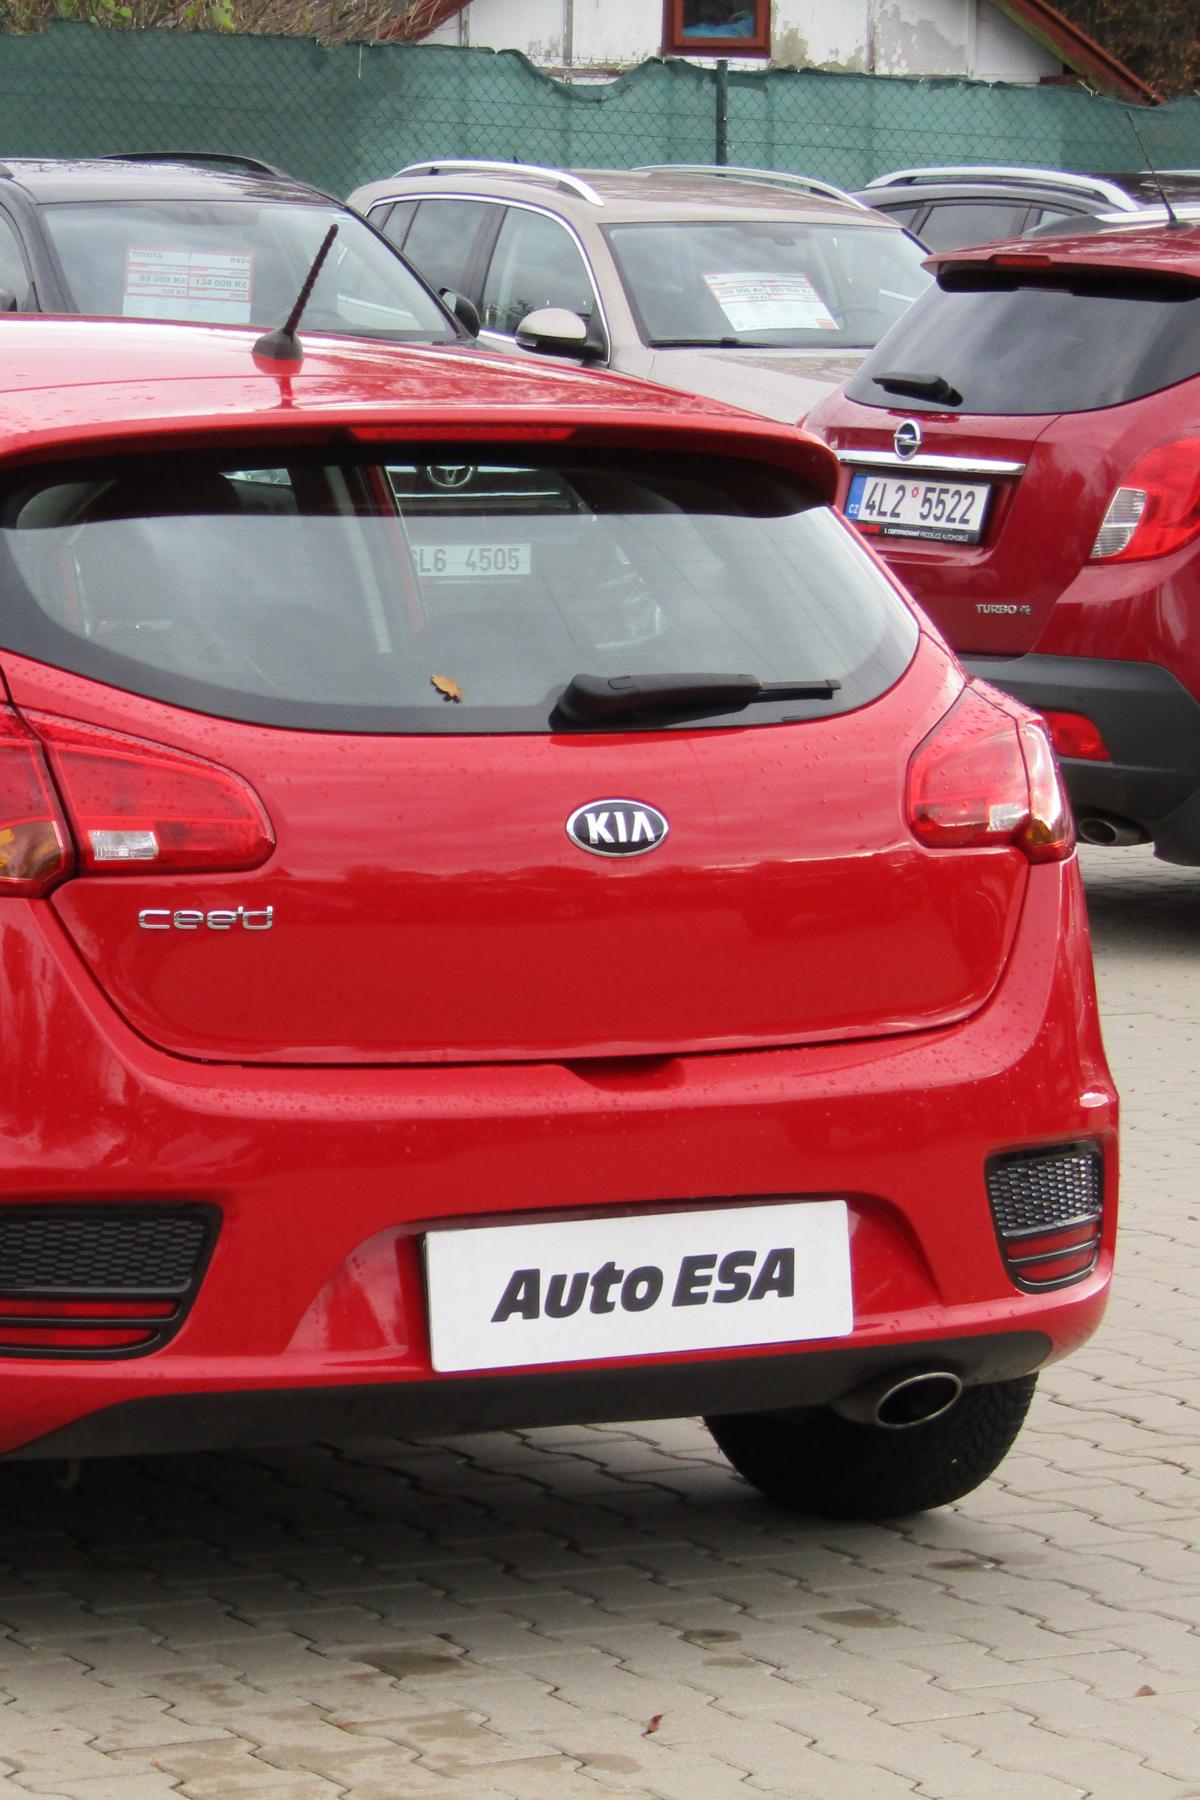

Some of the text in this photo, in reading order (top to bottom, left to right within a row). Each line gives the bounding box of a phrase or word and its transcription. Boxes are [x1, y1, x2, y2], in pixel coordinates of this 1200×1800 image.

[131, 250, 163, 259] TOYOTA
[174, 276, 187, 285] Kč
[195, 278, 248, 289] 134 000 Kč
[848, 504, 860, 514] CZ
[864, 482, 976, 525] 4L2 5522
[465, 547, 521, 572] 4505
[975, 604, 1018, 615] TURBO
[583, 810, 656, 844] KIA
[490, 1247, 795, 1323] Auto ESA
